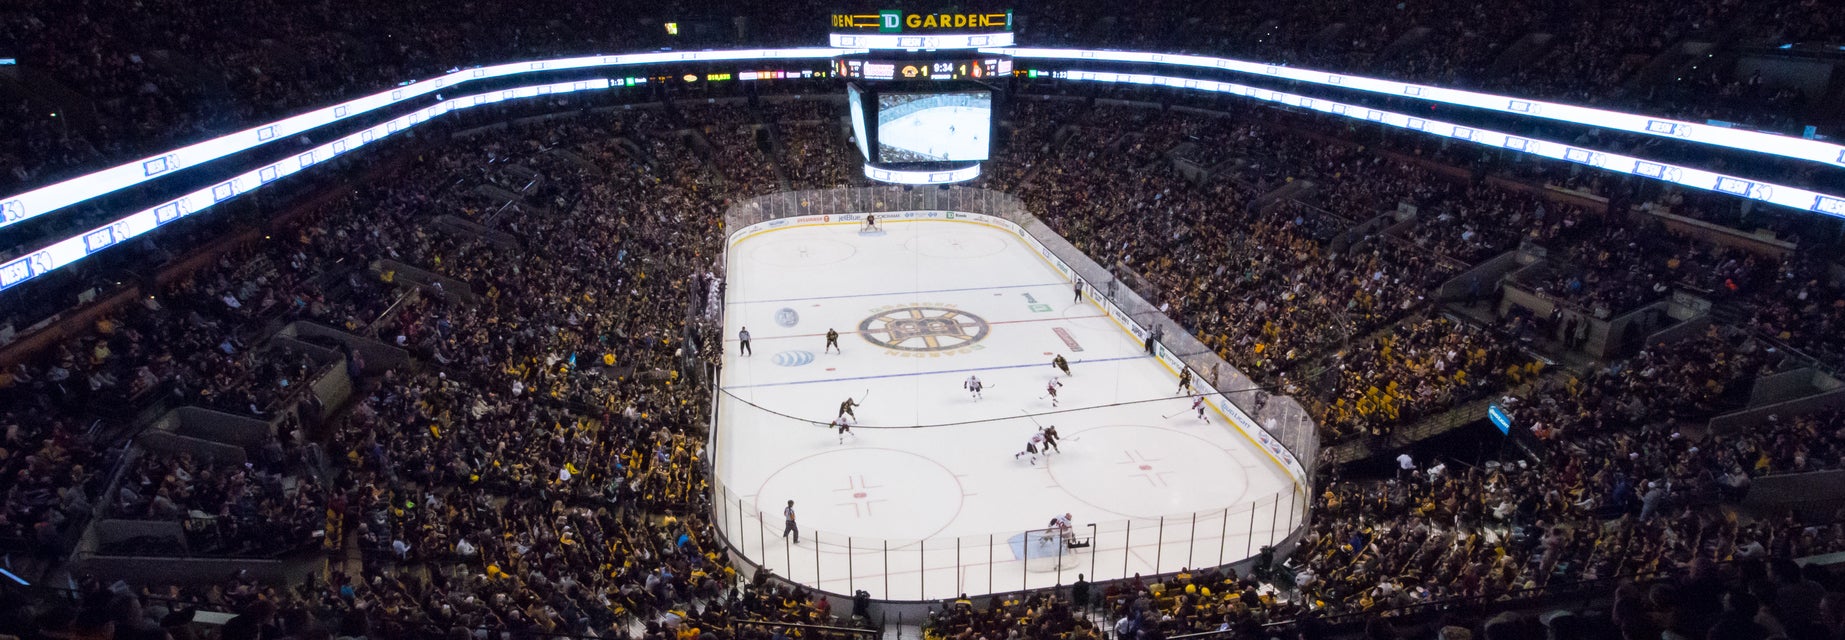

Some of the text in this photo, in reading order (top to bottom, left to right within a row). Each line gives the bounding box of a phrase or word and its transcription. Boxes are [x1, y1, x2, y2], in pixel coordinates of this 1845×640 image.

[832, 14, 854, 28] DEN
[881, 13, 990, 28] TD GARDEN
[933, 62, 954, 73] 9:34
